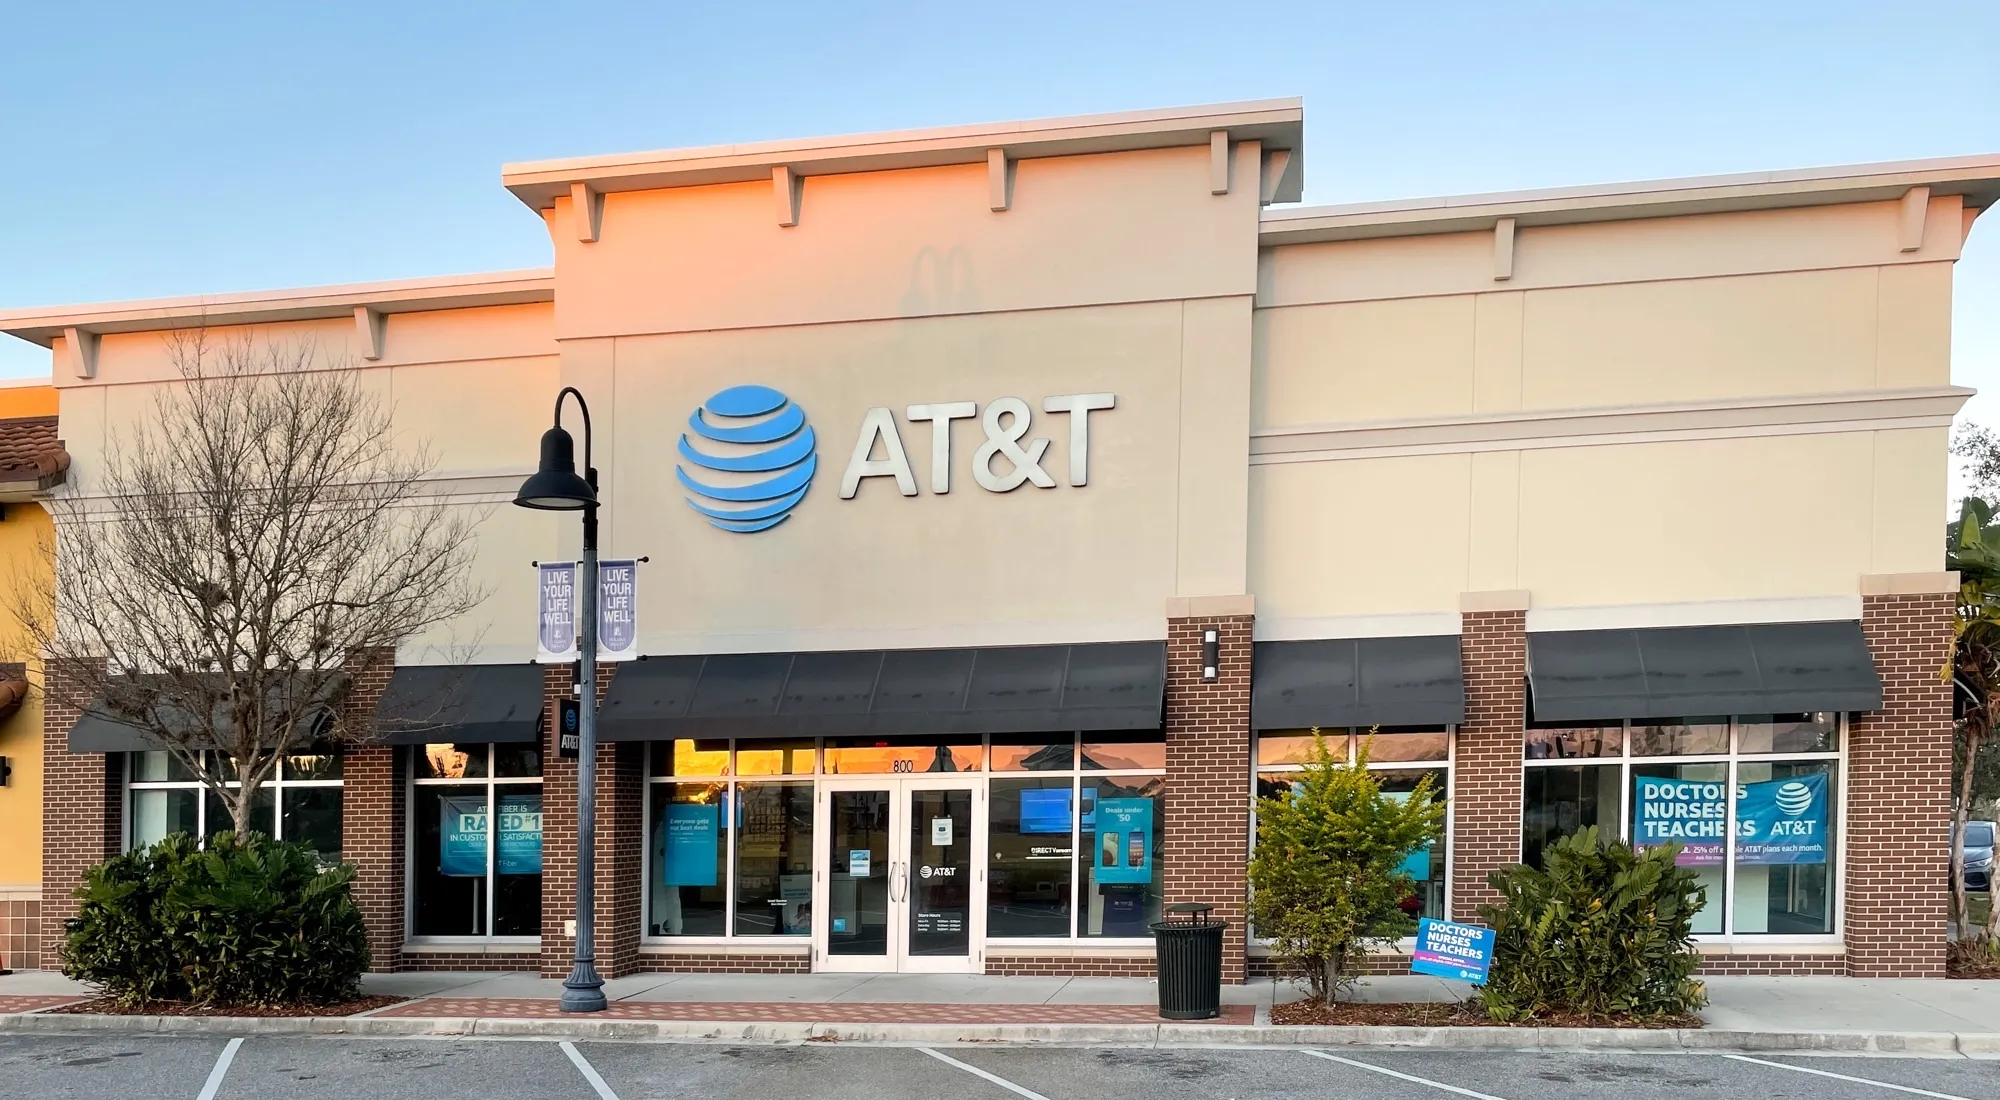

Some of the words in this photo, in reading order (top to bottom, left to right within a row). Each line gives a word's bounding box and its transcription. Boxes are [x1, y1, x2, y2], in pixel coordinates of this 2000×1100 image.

[838, 392, 1116, 500] AT&T
[547, 570, 569, 584] LIVE
[606, 568, 629, 582] LIVE
[543, 584, 571, 597] YOUR
[603, 582, 631, 595] YOUR
[548, 598, 568, 612] LIFE
[607, 596, 628, 609] LIFE
[544, 612, 571, 625] WELL
[603, 610, 631, 623] WELL
[561, 734, 580, 750] AT&T
[893, 760, 914, 773] 800
[498, 805, 518, 813] FIBER
[520, 804, 528, 813] IS
[1644, 802, 1726, 819] NURSES
[464, 815, 523, 831] RAED
[525, 814, 540, 830] #1
[669, 818, 696, 826] Everyone
[696, 818, 709, 826] gets
[1770, 819, 1817, 836] AT&T
[450, 834, 458, 842] IN
[459, 833, 502, 841] CUSTO
[1693, 846, 1708, 854] 25%
[1708, 845, 1719, 854] off
[1744, 845, 1762, 853] AT&T
[1762, 844, 1781, 854] plans
[1782, 844, 1797, 852] each
[1798, 843, 1824, 852] month.
[933, 866, 957, 877] AT&T
[1428, 922, 1484, 940] DOCTORS
[1427, 932, 1471, 948] NURSES
[1426, 941, 1484, 960] TEACHERS
